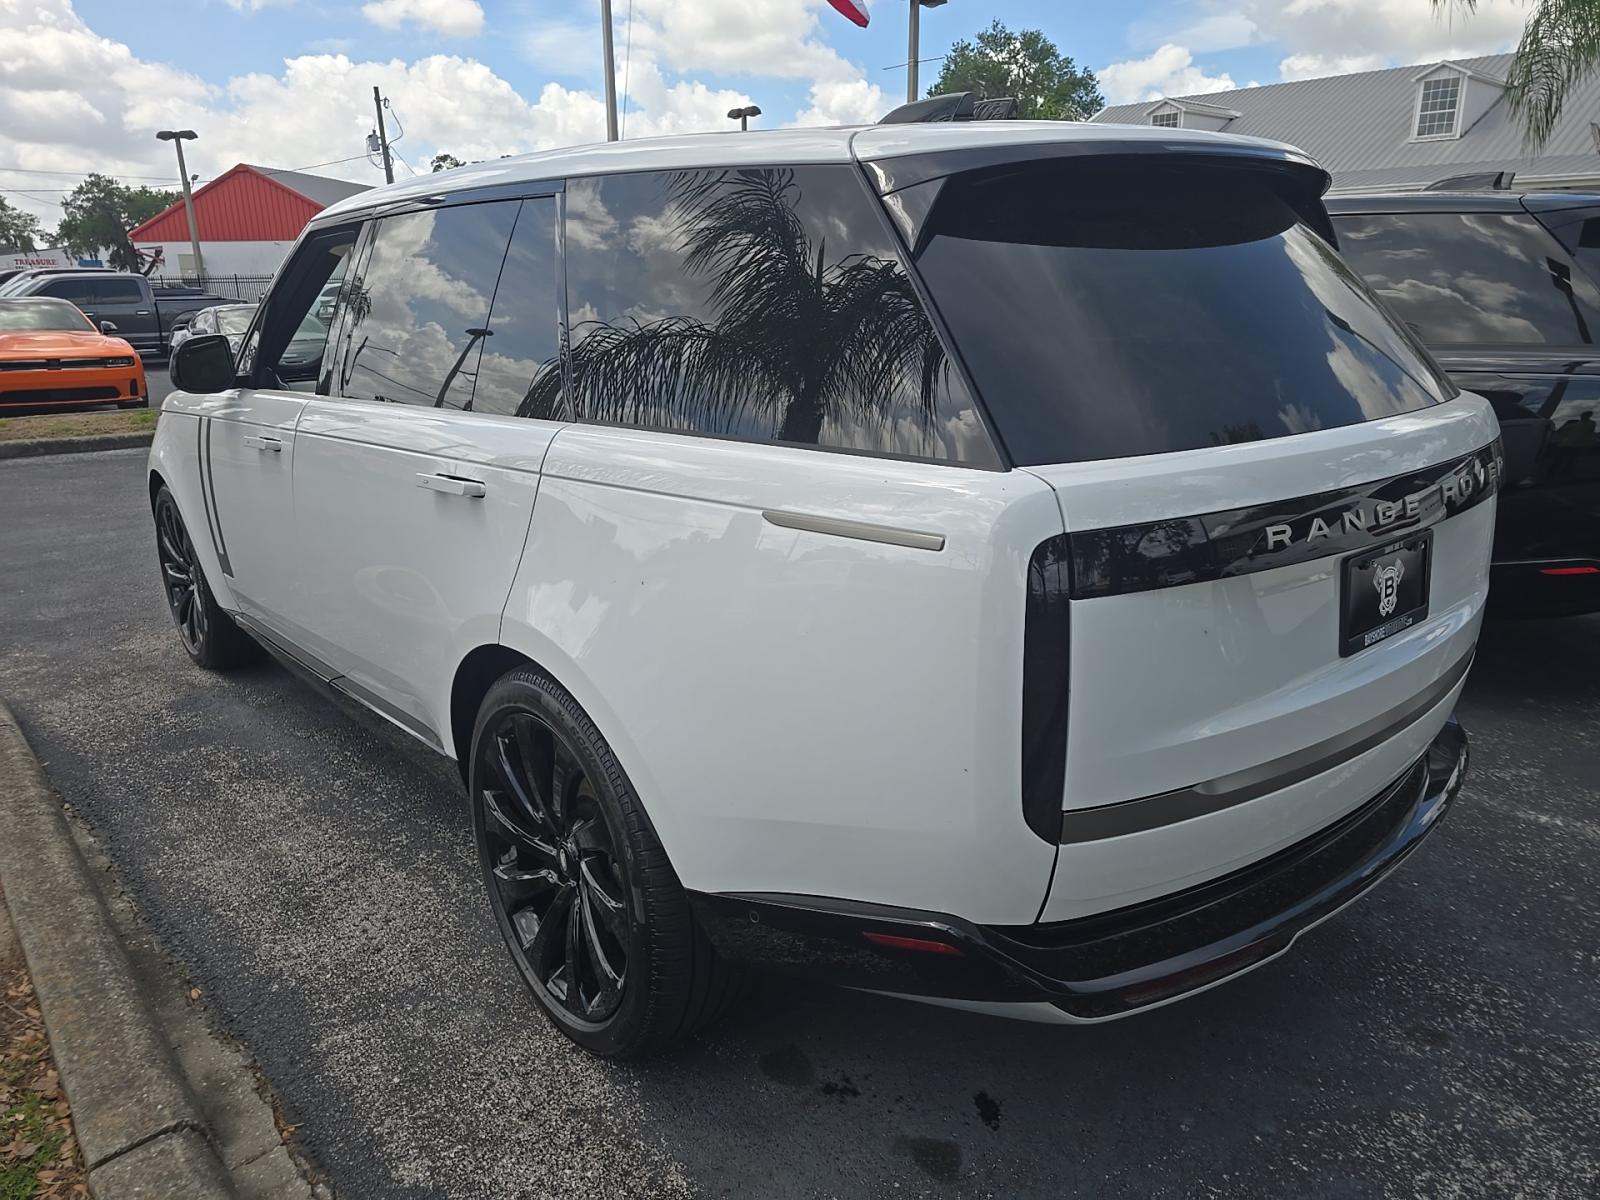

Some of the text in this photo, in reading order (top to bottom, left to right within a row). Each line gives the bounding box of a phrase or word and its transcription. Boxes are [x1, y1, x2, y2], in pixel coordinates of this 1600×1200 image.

[14, 258, 57, 266] TREASURE
[1266, 498, 1421, 550] RANGE
[1384, 576, 1395, 599] B
